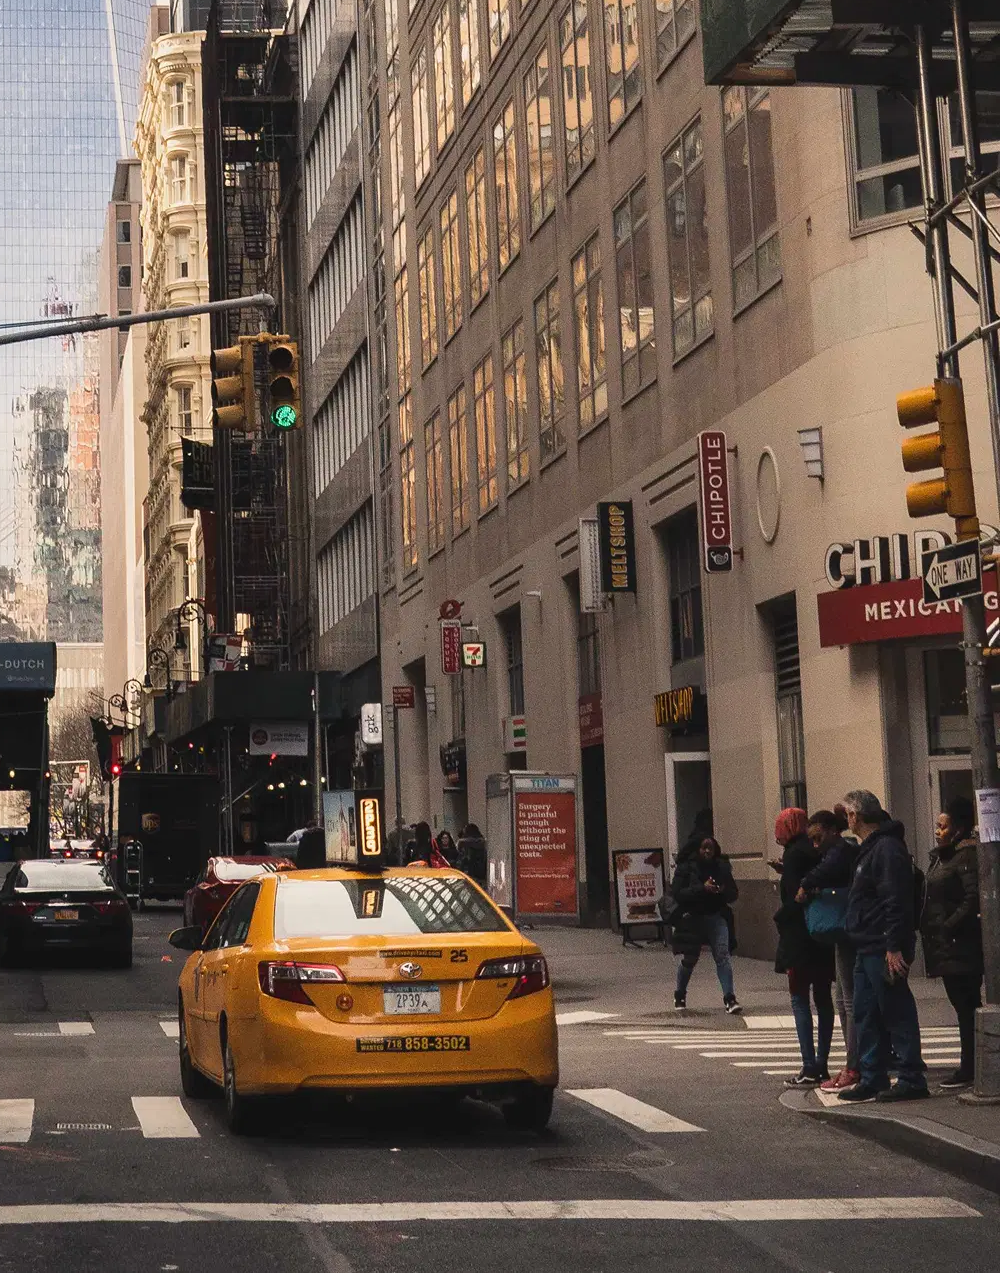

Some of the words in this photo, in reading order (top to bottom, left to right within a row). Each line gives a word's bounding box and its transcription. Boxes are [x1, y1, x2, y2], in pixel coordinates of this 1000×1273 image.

[707, 437, 726, 539] CHIPOTLE
[825, 524, 998, 589] CHIP
[931, 564, 948, 586] ONE
[955, 557, 973, 581] WAY
[530, 778, 560, 787] TITAN
[519, 803, 551, 811] Surgery
[527, 810, 557, 819] painful
[519, 819, 549, 827] enough
[519, 834, 540, 843] sting
[541, 834, 550, 842] of
[519, 842, 566, 851] unexpected
[626, 887, 656, 898] HOT
[450, 949, 469, 963] 25
[387, 1039, 401, 1049] 718
[405, 1037, 466, 1050] 858-3502
